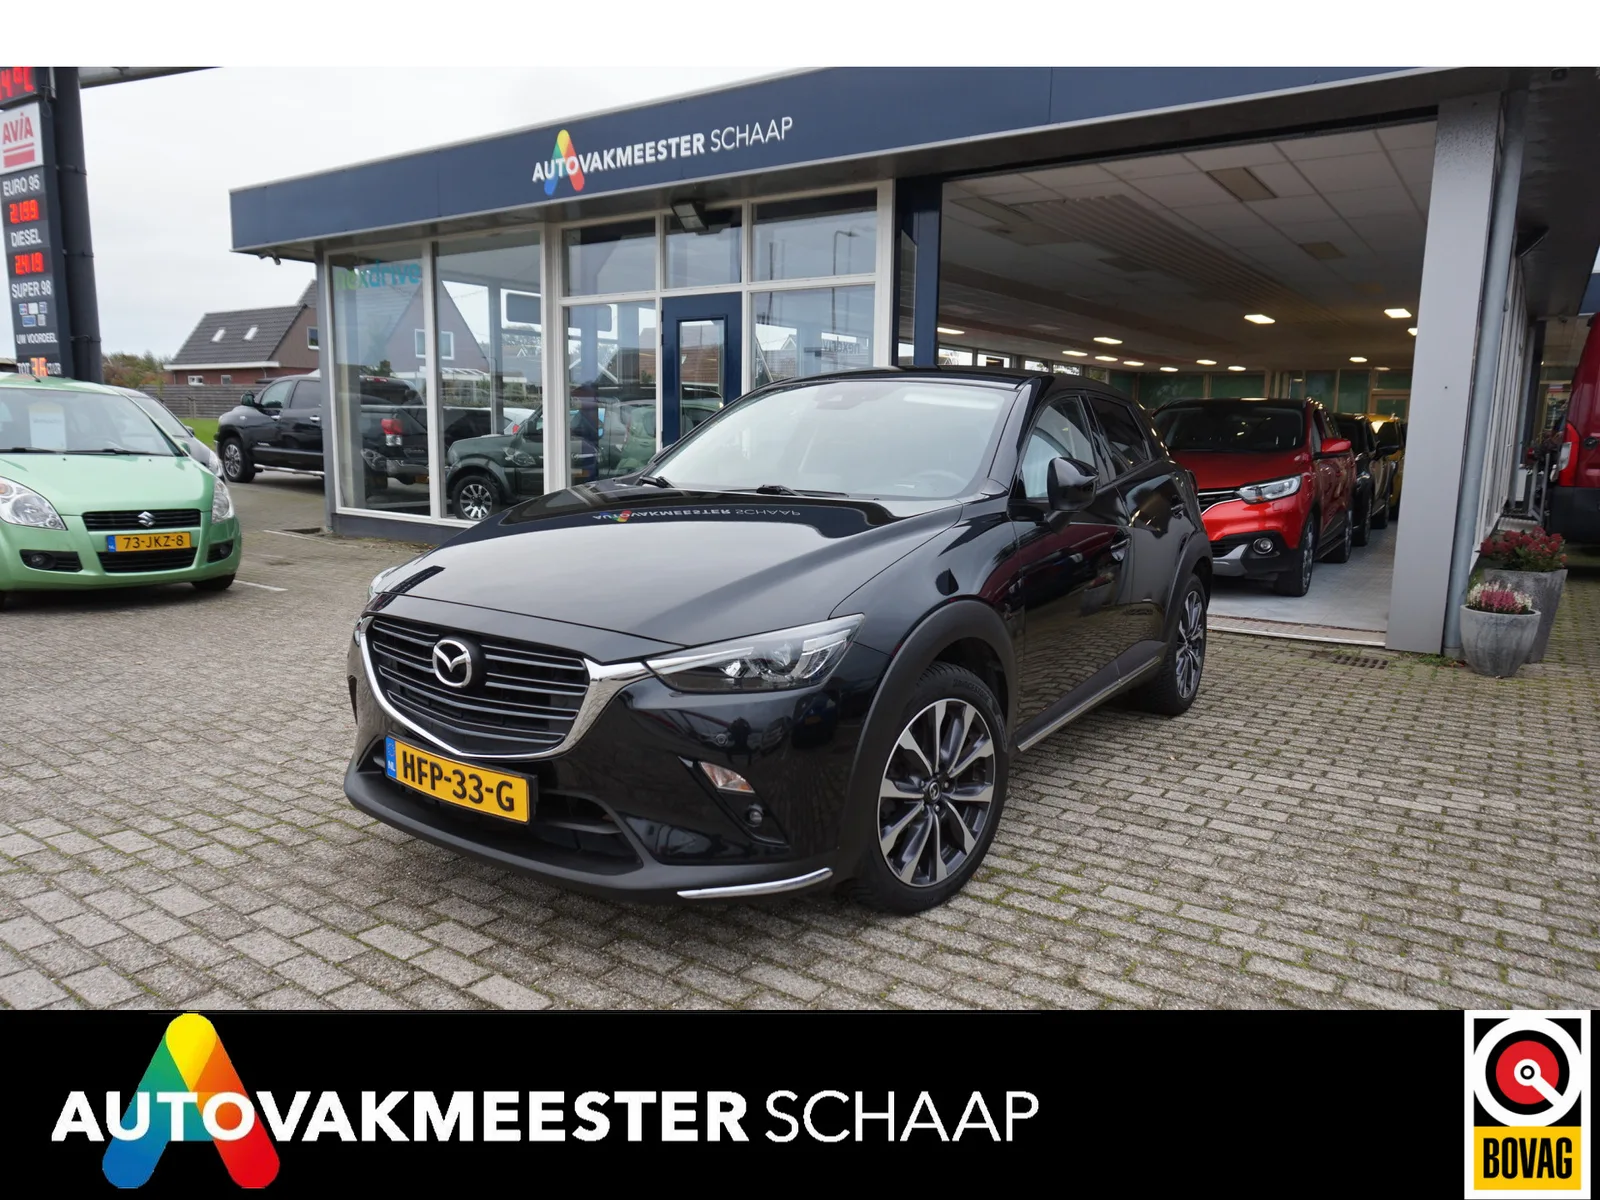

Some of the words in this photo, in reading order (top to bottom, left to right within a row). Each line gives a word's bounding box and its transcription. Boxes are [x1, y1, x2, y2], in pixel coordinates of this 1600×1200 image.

[532, 133, 706, 183] AUTOVAKMEESTER
[710, 116, 793, 151] SCHAAP
[3, 176, 27, 197] EURO
[28, 174, 40, 191] 95
[11, 228, 42, 247] DIESEL
[11, 281, 40, 298] SUPER
[40, 280, 52, 295] 98
[124, 535, 184, 549] 73-JKZ-8
[387, 760, 396, 773] NL
[402, 750, 514, 812] HFP-33-G
